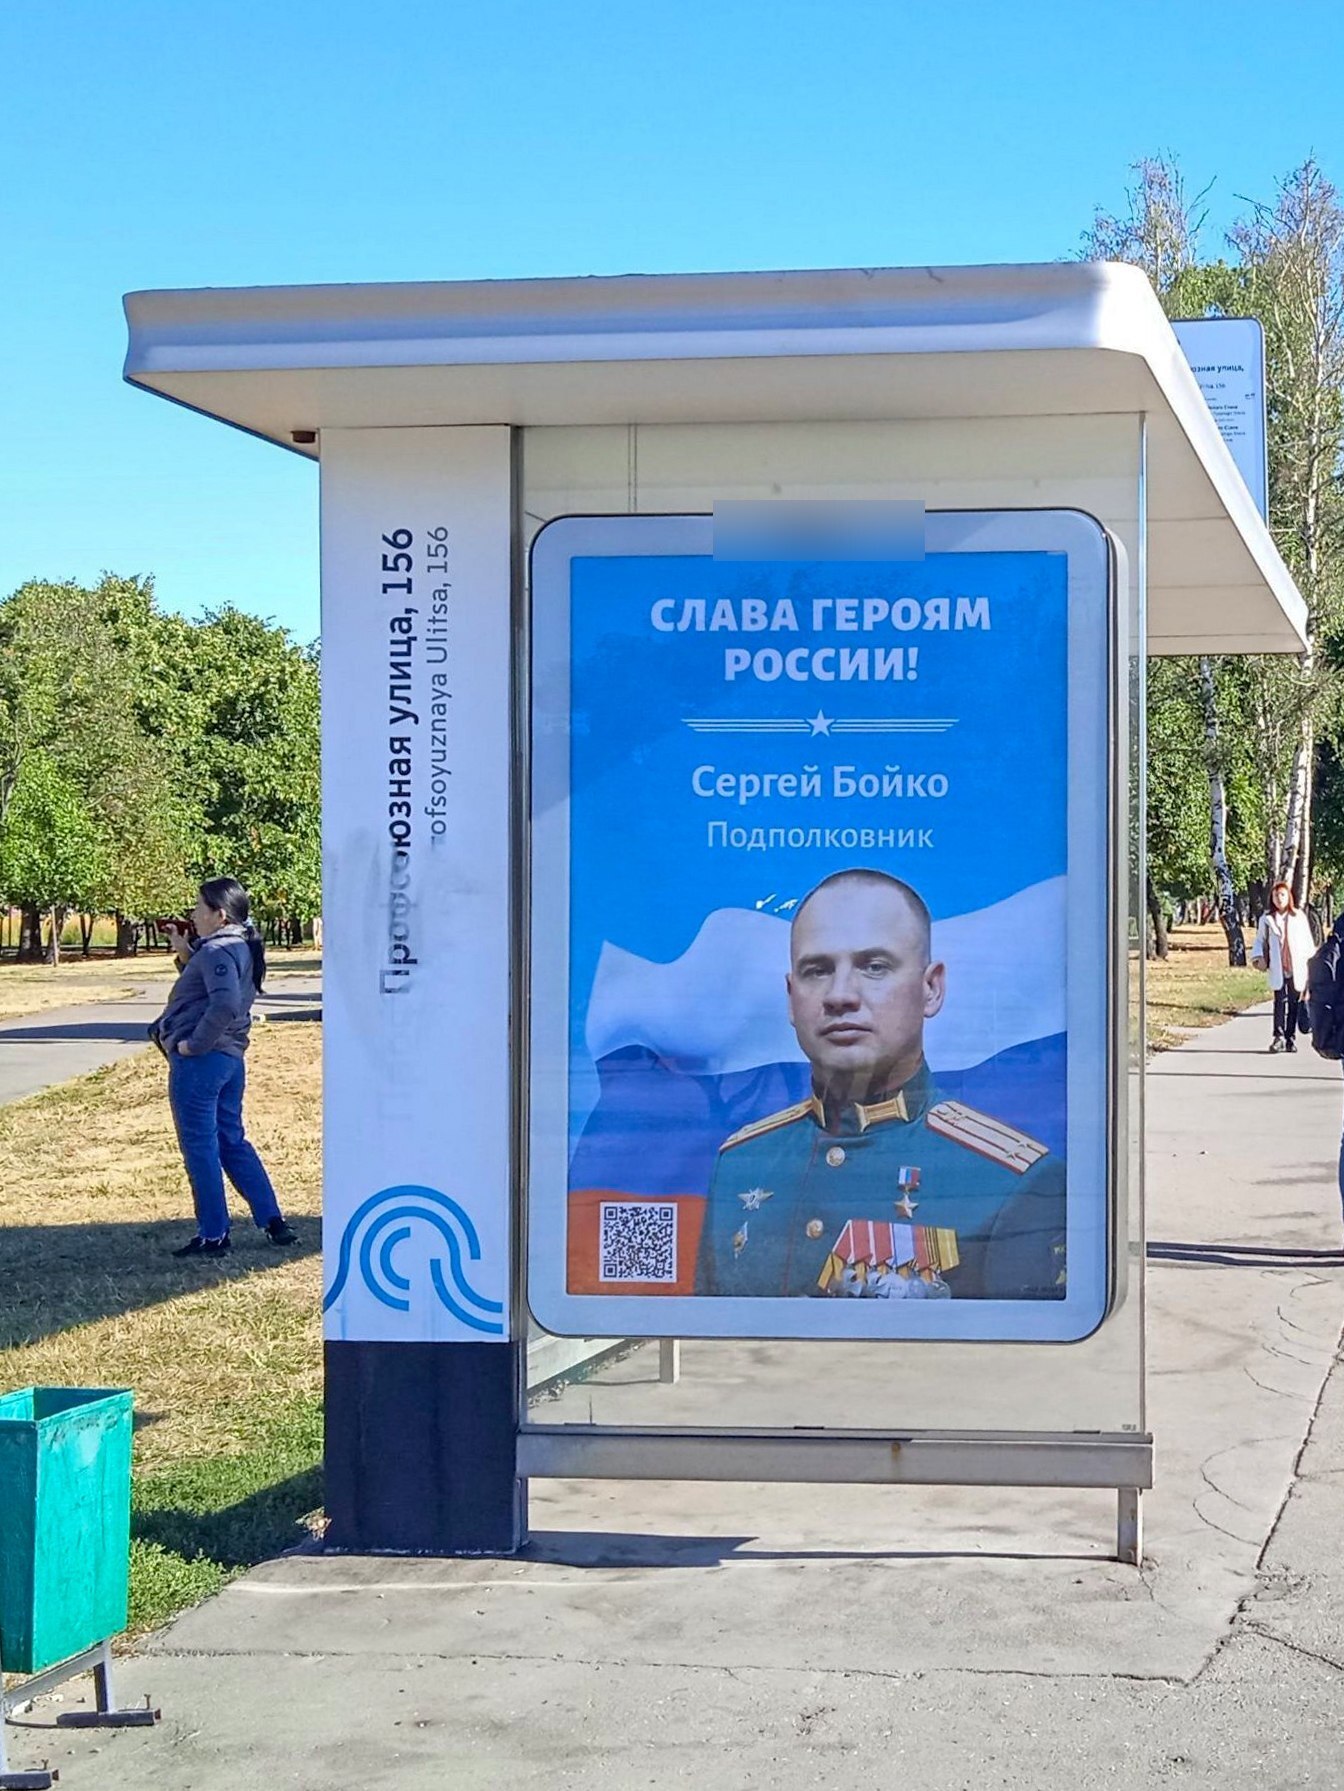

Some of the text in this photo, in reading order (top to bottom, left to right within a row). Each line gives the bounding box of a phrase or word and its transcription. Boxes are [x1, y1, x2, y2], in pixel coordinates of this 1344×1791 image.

[650, 597, 991, 632] СЛАВА ГЕРОЯМ
[725, 646, 919, 682] РОССИИ!
[425, 526, 453, 849] ofsoyuznaya Ulitsa, 156
[380, 528, 419, 994] Профсоюзная улица, 156
[692, 765, 949, 806] Сергей Бойко
[707, 820, 934, 852] Подполковник
